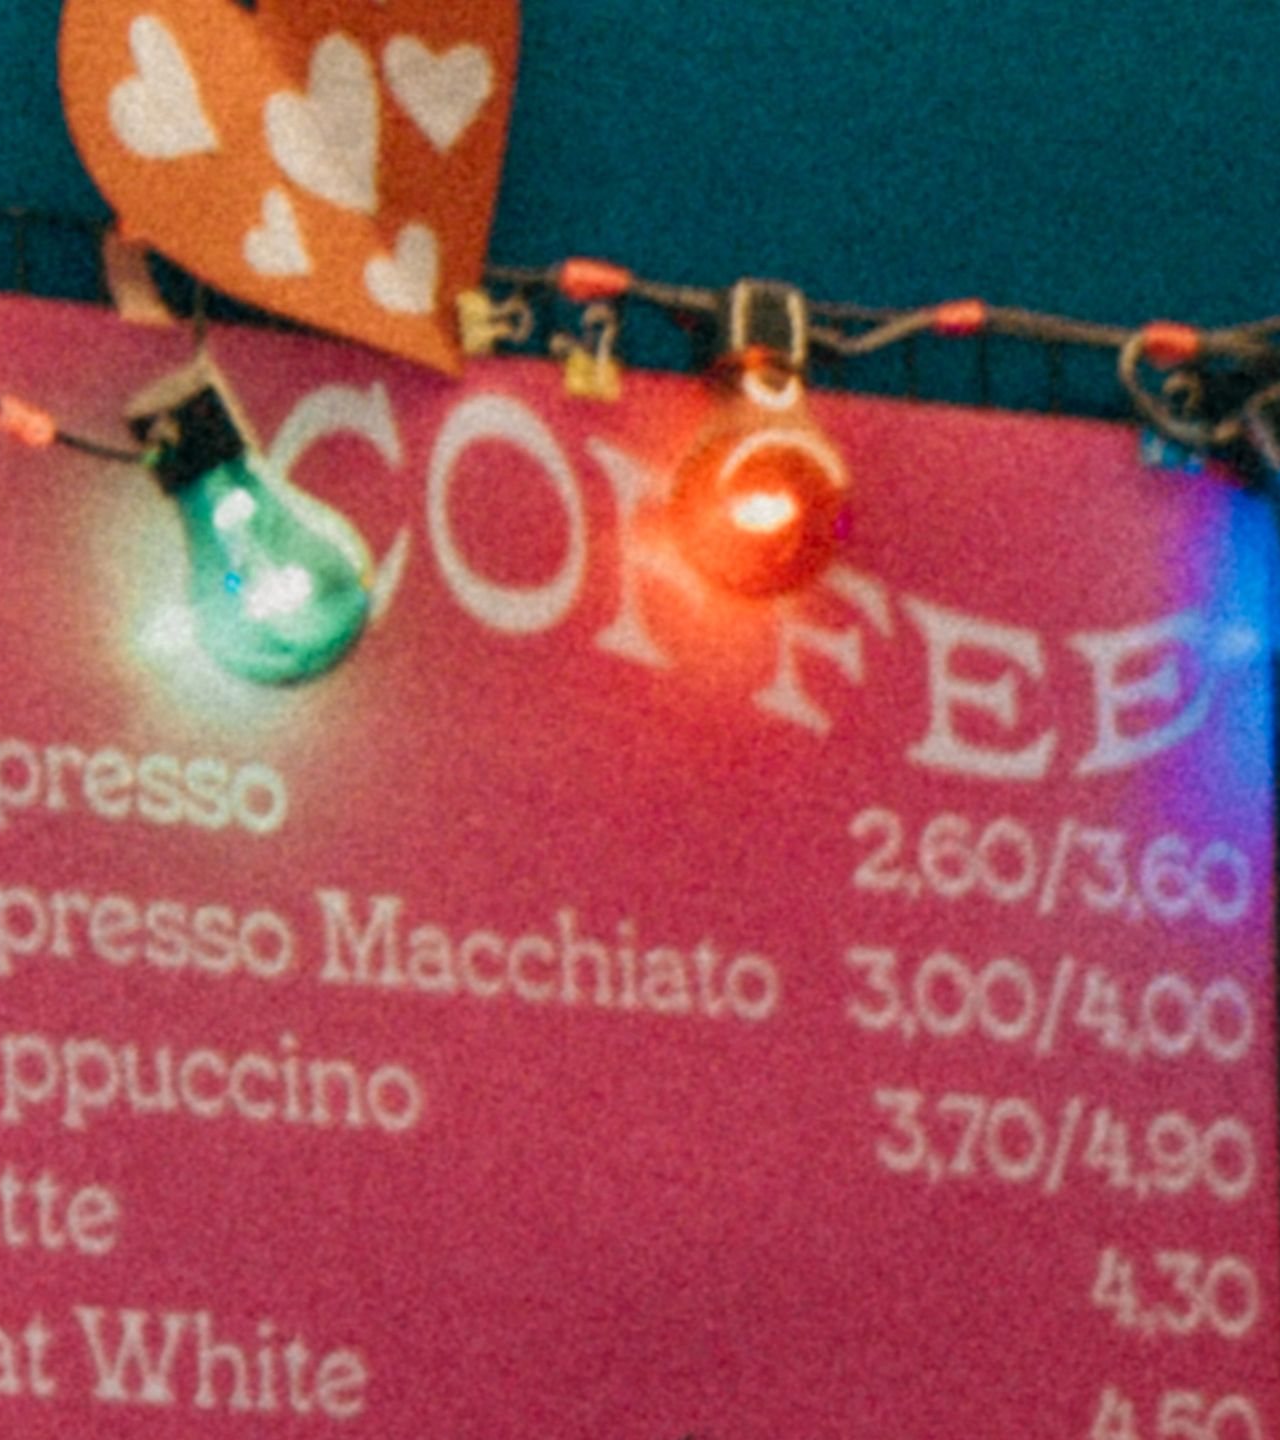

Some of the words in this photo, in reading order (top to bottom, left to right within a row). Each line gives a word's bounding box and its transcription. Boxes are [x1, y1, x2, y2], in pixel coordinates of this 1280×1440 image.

[848, 807, 1255, 925] 2,60/3,60
[315, 887, 780, 1022] Macchiato
[844, 945, 1255, 1063] 3,00/4,00
[871, 1084, 1258, 1200] 3,70/4,90
[1090, 1247, 1260, 1339] 4,30
[74, 1306, 371, 1419] White
